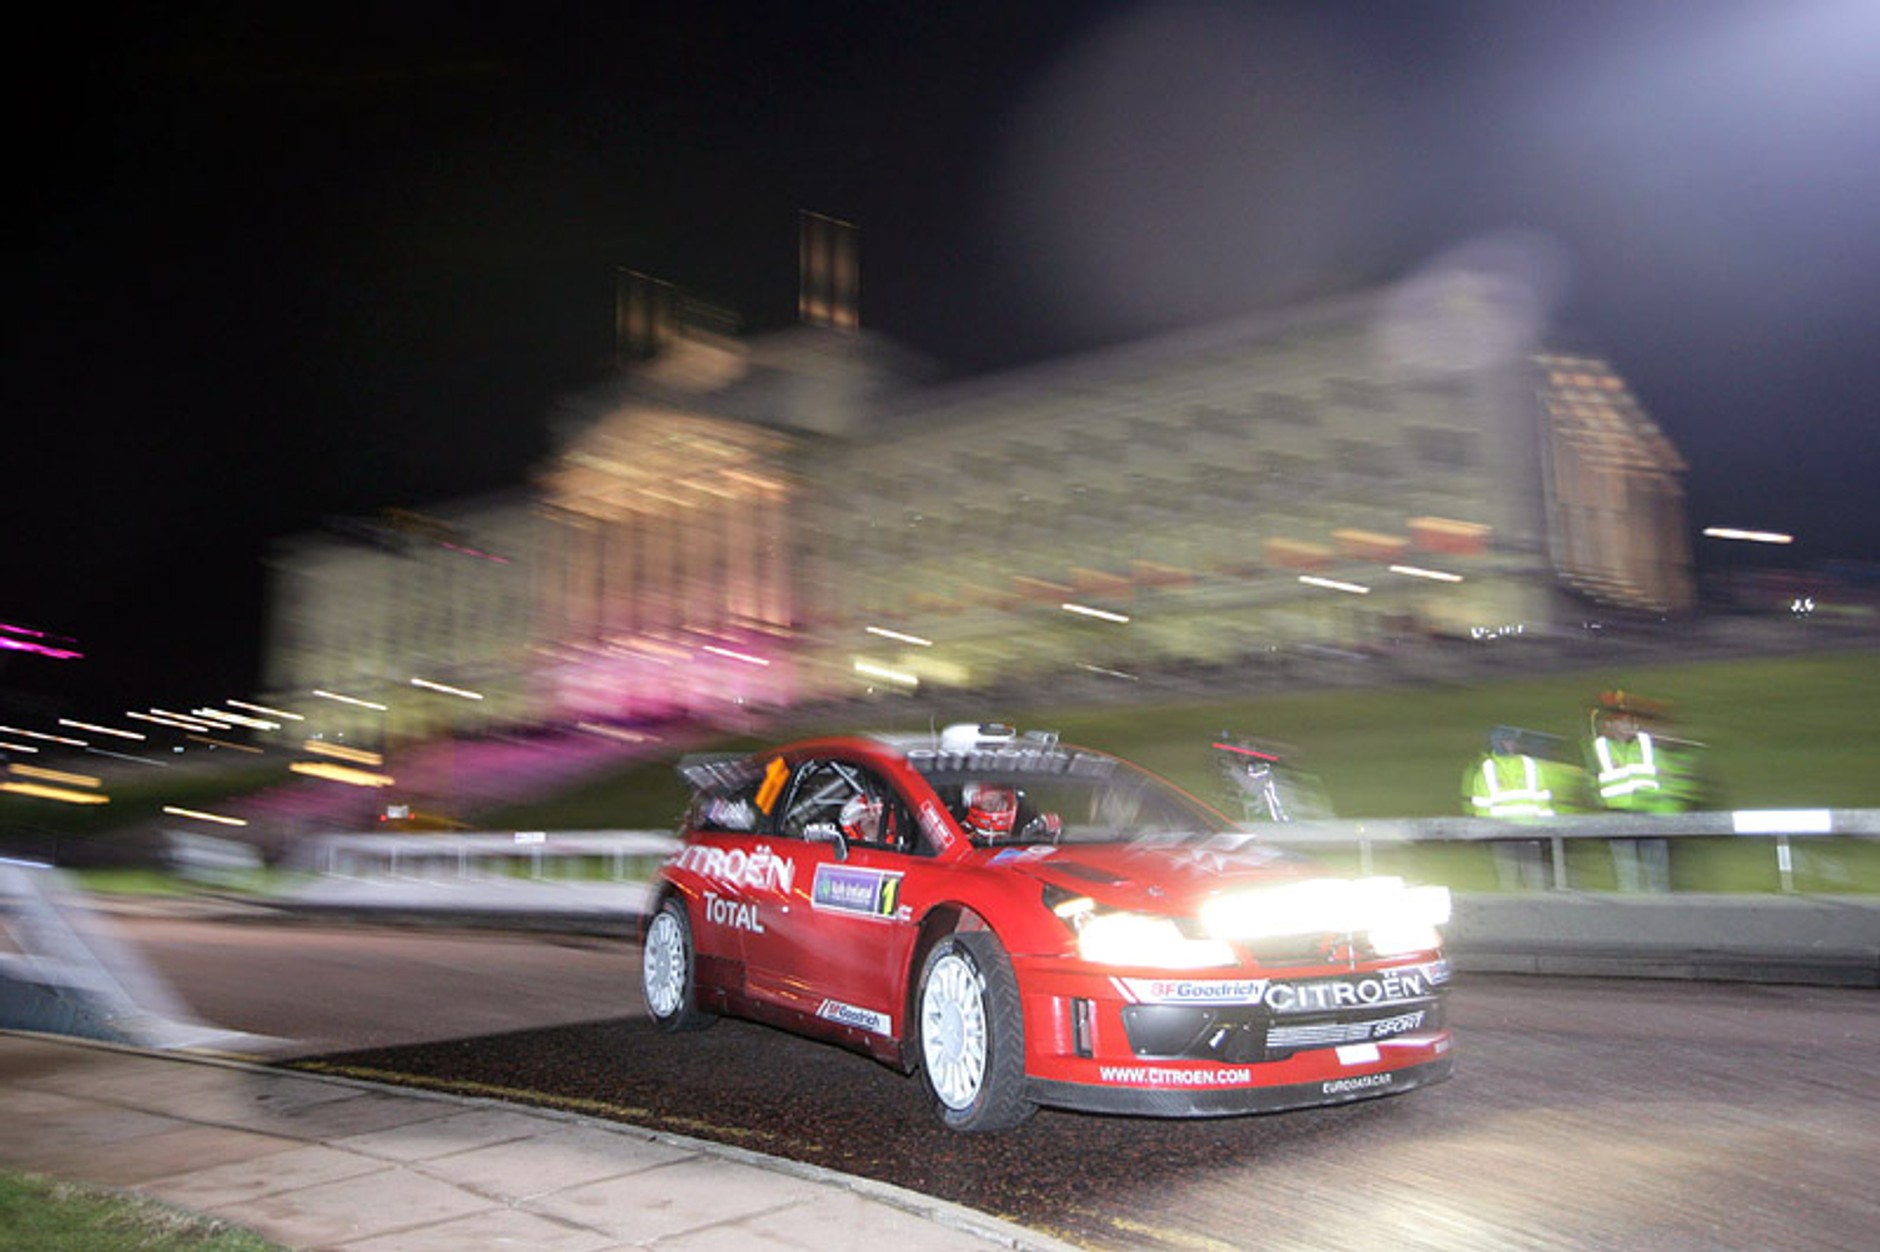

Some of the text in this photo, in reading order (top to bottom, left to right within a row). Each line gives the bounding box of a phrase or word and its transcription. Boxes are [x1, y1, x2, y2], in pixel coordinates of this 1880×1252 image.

[703, 890, 765, 934] TOTAL
[882, 878, 898, 917] 1
[1151, 982, 1259, 998] BFGoodrich
[1264, 970, 1423, 1010] CITROËN
[1373, 1010, 1426, 1038] SPORT
[1099, 1066, 1251, 1084] WWW.CITROEN.COM
